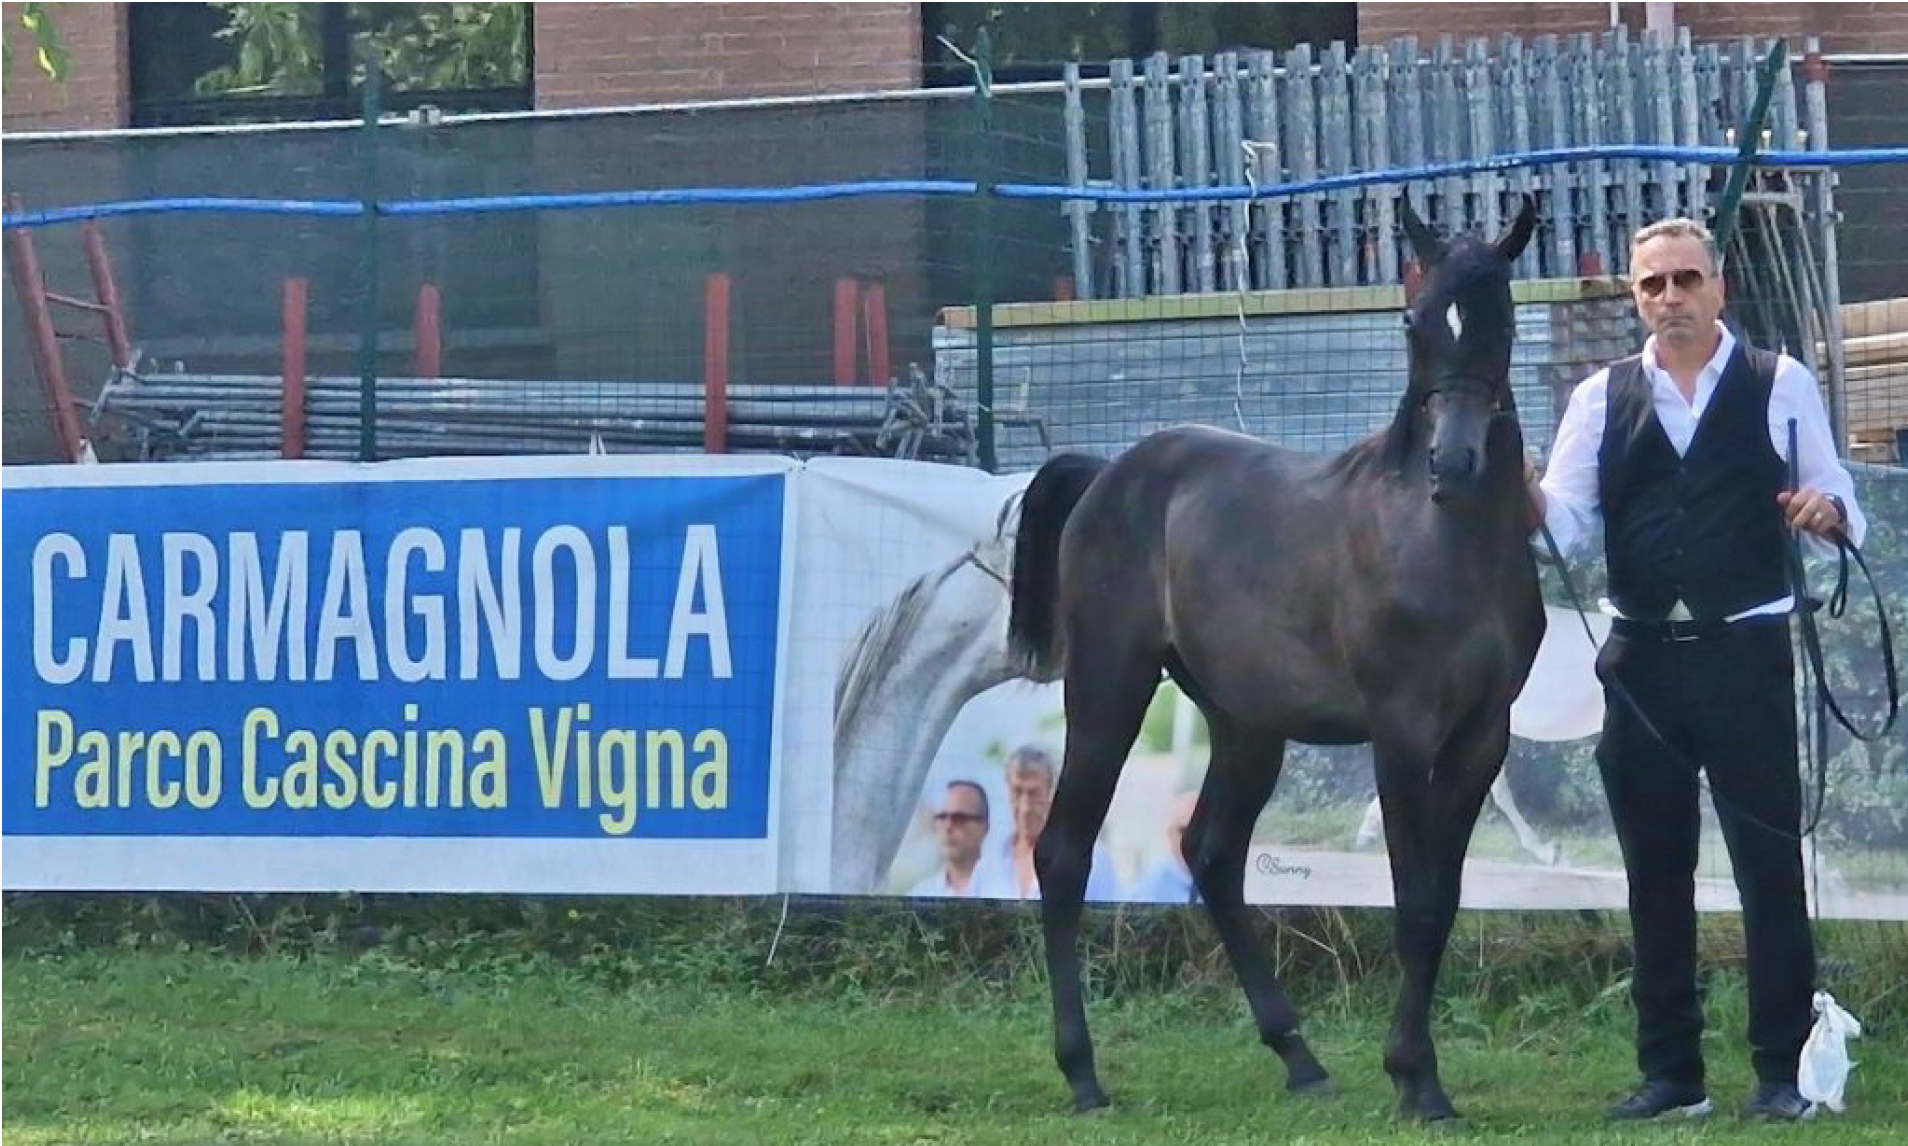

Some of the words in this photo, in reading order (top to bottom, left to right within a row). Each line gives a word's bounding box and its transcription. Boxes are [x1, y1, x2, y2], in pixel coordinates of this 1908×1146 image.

[32, 525, 732, 684] CARMAGNOLA
[35, 709, 222, 808] Parco
[242, 703, 507, 808] Cascina
[529, 703, 728, 834] Vigna
